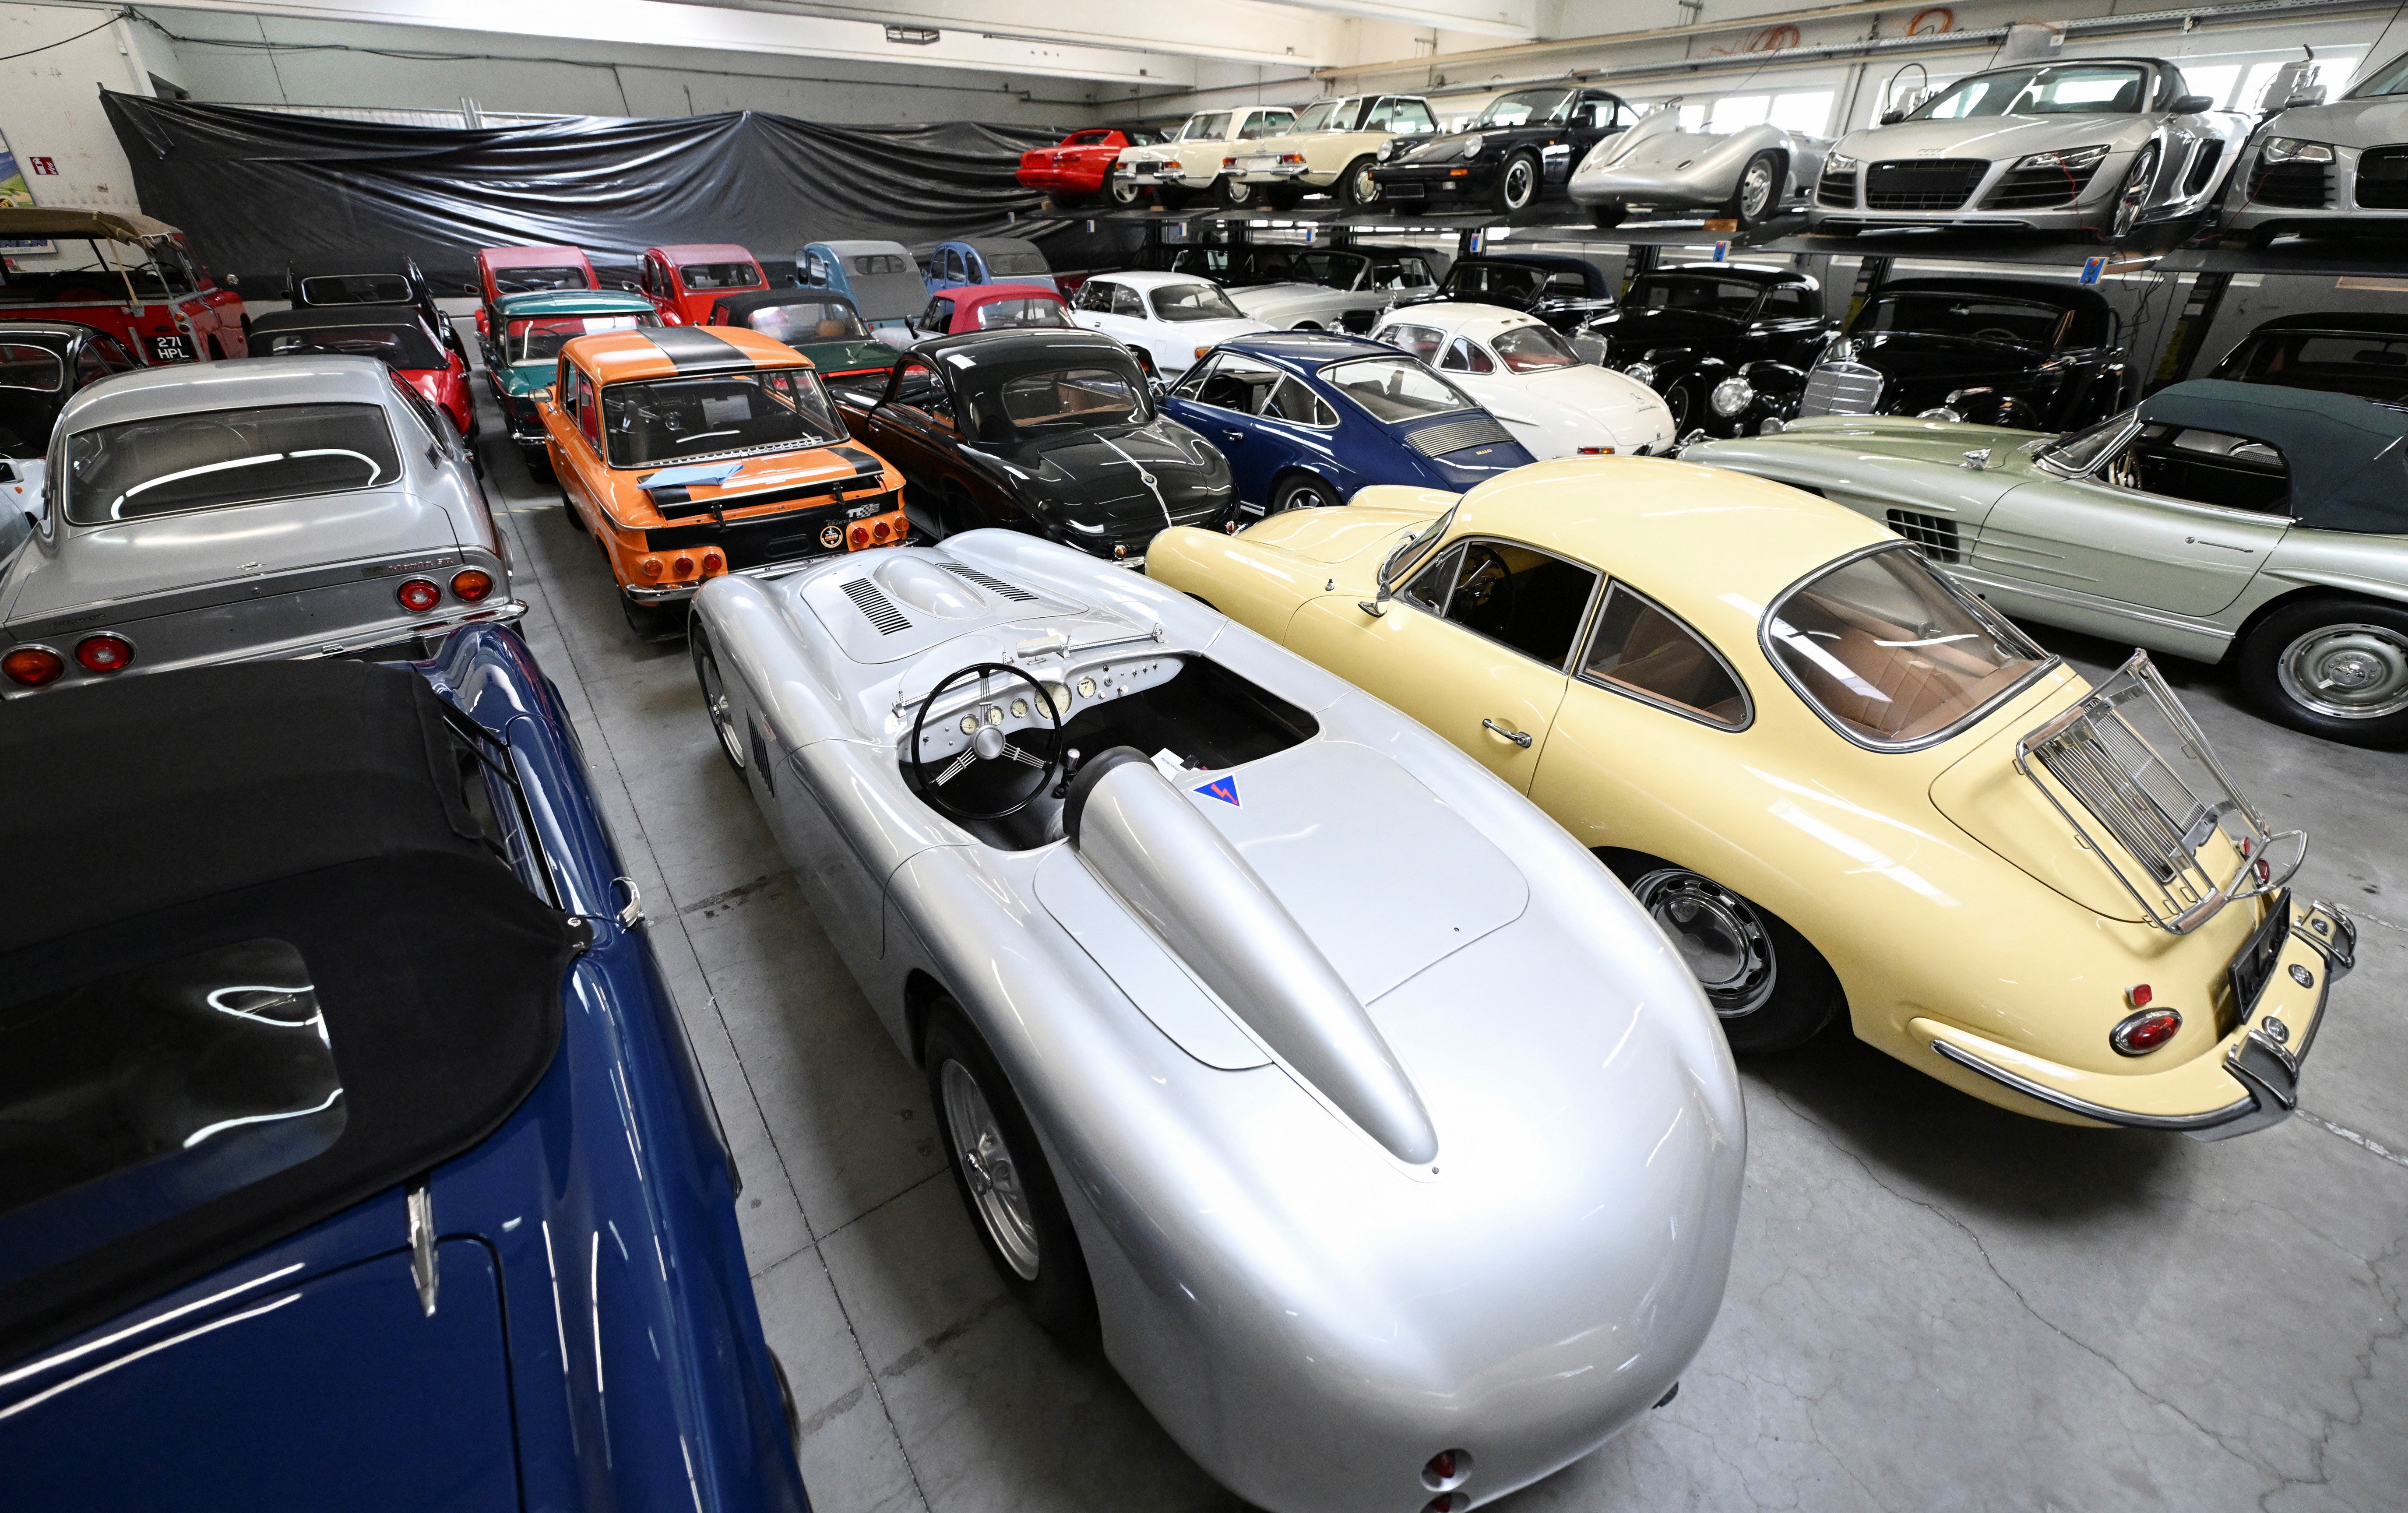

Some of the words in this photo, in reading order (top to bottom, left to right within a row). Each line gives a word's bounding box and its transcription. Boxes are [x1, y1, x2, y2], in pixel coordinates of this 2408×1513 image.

[157, 336, 182, 347] 271
[158, 348, 190, 359] HPL
[388, 561, 433, 572] Manta
